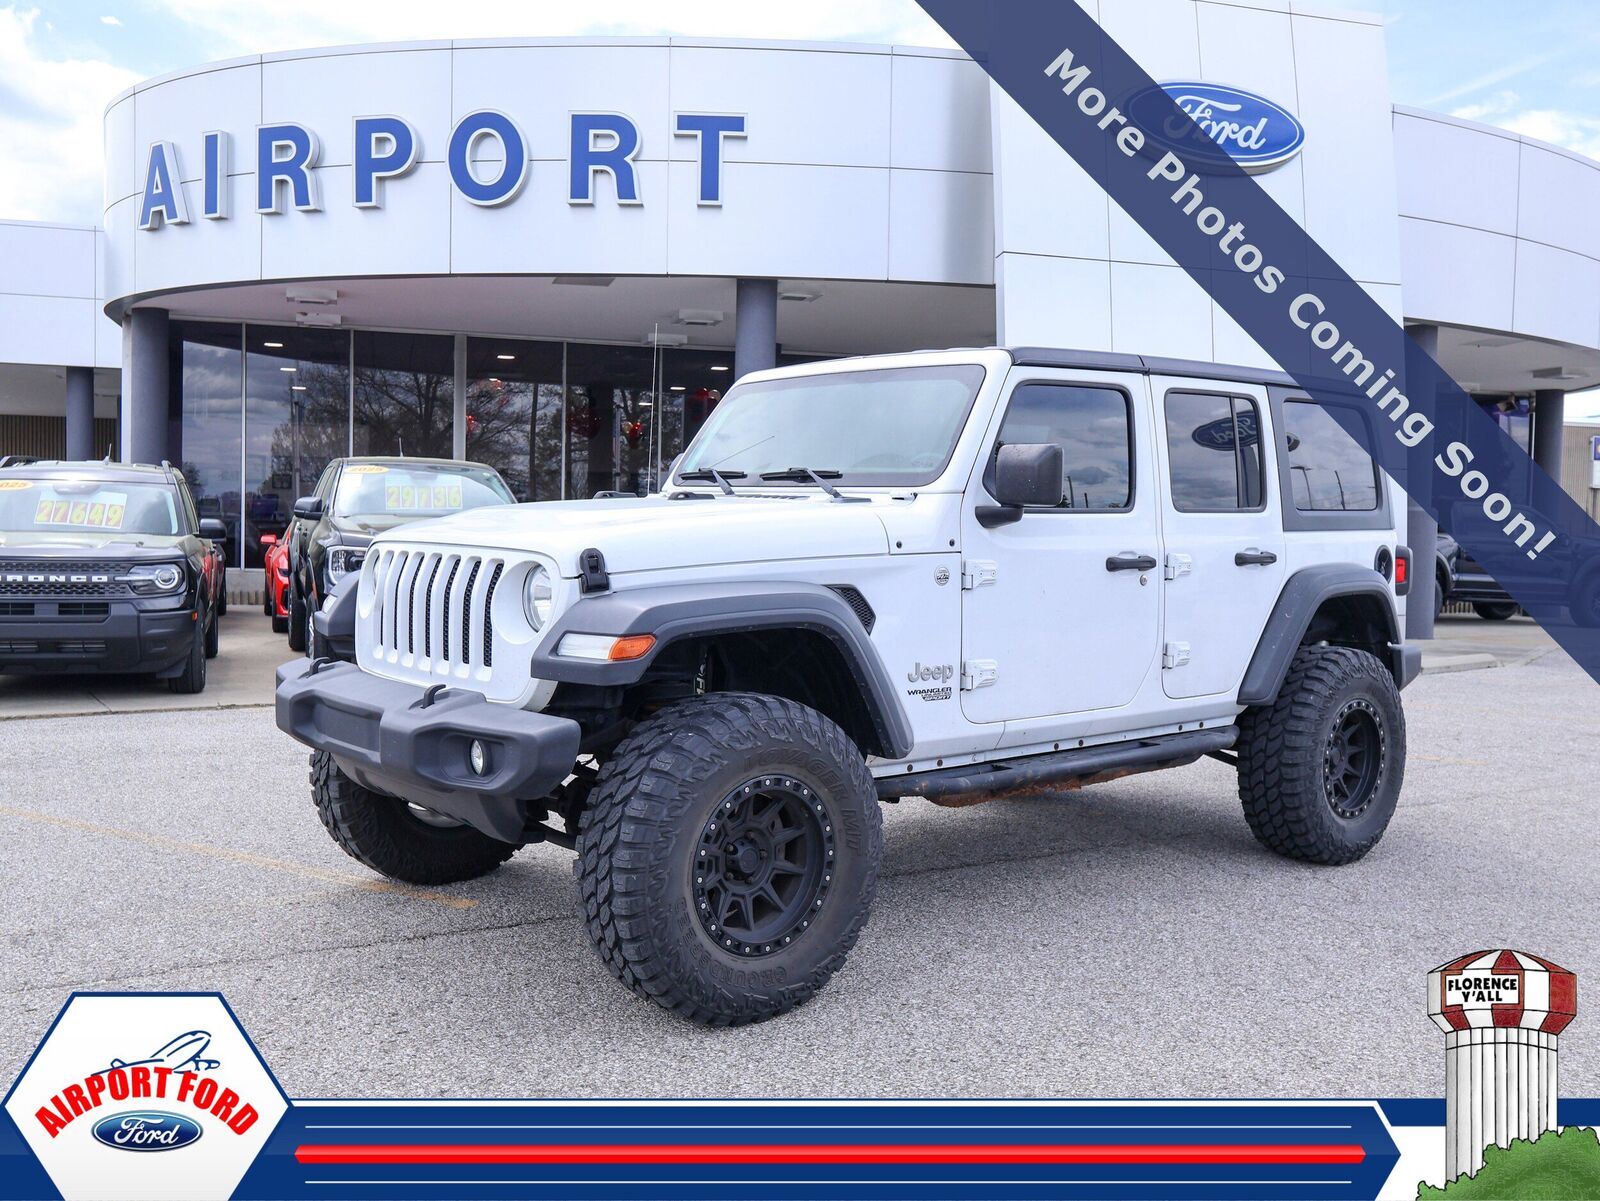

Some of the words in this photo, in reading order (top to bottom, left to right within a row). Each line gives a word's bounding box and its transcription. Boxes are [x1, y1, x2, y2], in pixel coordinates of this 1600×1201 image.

[1162, 95, 1268, 150] Ford
[138, 109, 748, 230] AIRPORT
[36, 500, 125, 527] 27649
[907, 662, 954, 684] Jeep
[907, 687, 953, 696] WRANGLER
